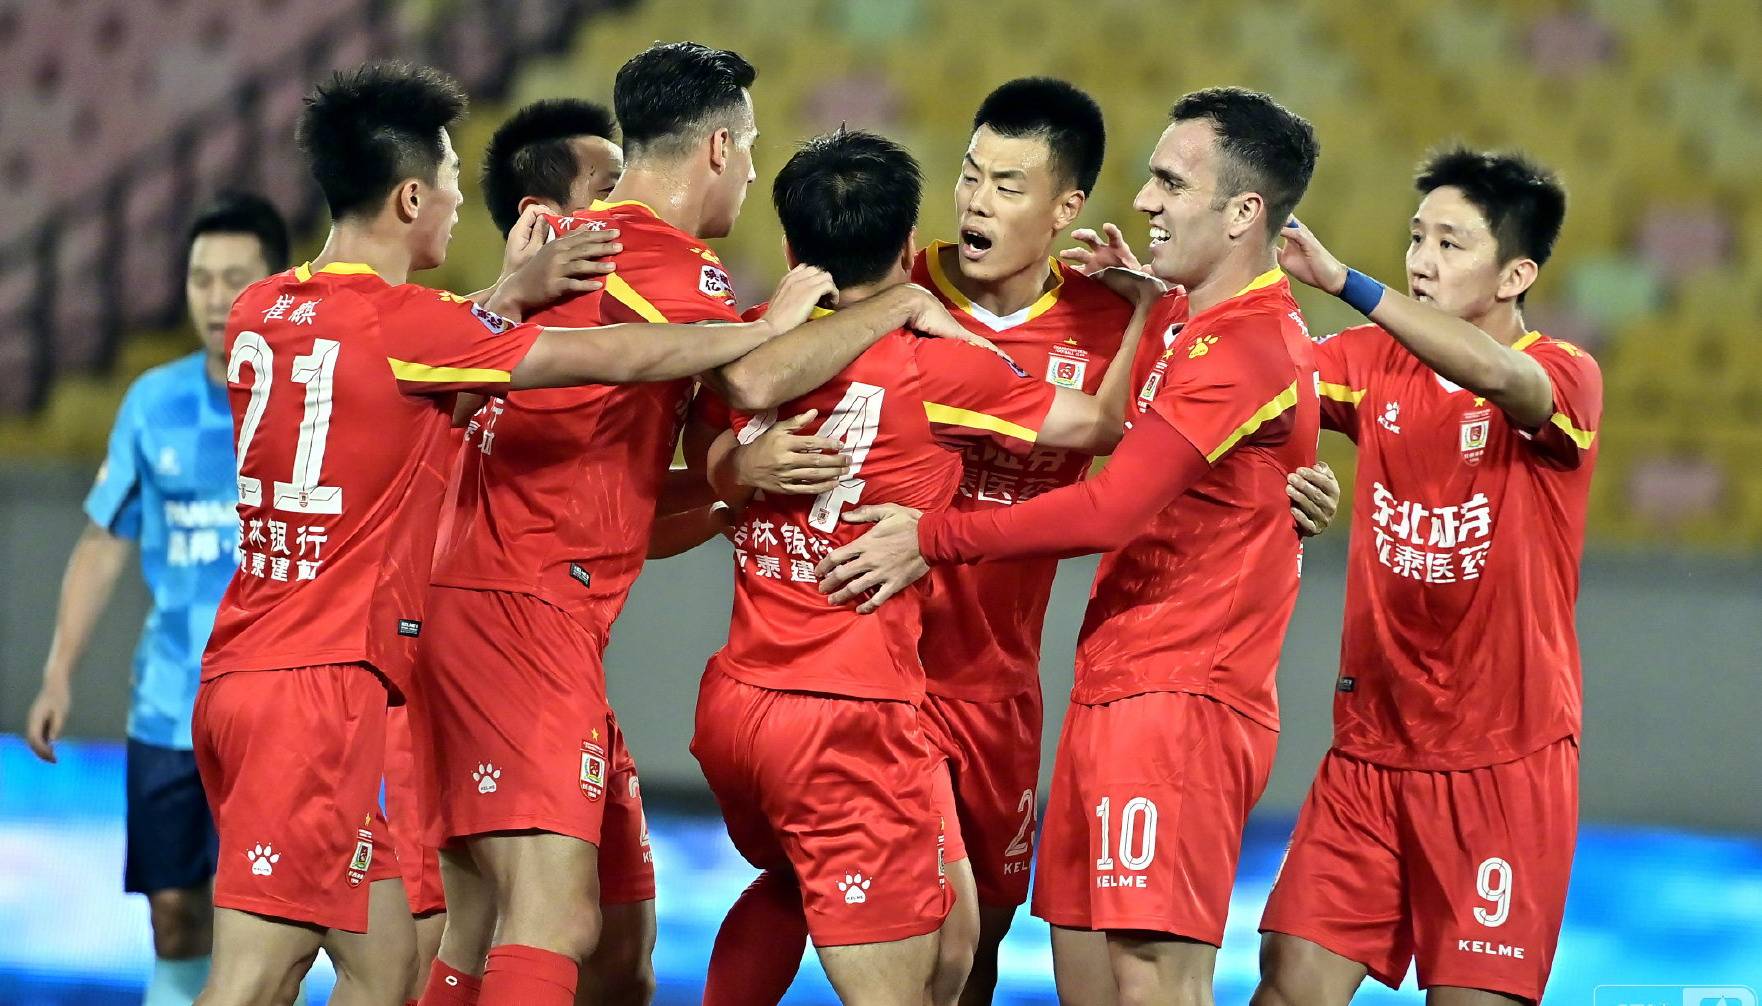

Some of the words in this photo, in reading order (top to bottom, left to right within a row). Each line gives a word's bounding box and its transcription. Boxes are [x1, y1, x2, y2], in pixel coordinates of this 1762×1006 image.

[227, 331, 343, 514] 21
[240, 517, 328, 559] 林银行
[1372, 482, 1492, 548] 东北证券
[1096, 796, 1158, 871] 10
[1473, 857, 1513, 927] 9
[1458, 940, 1525, 960] KELME
